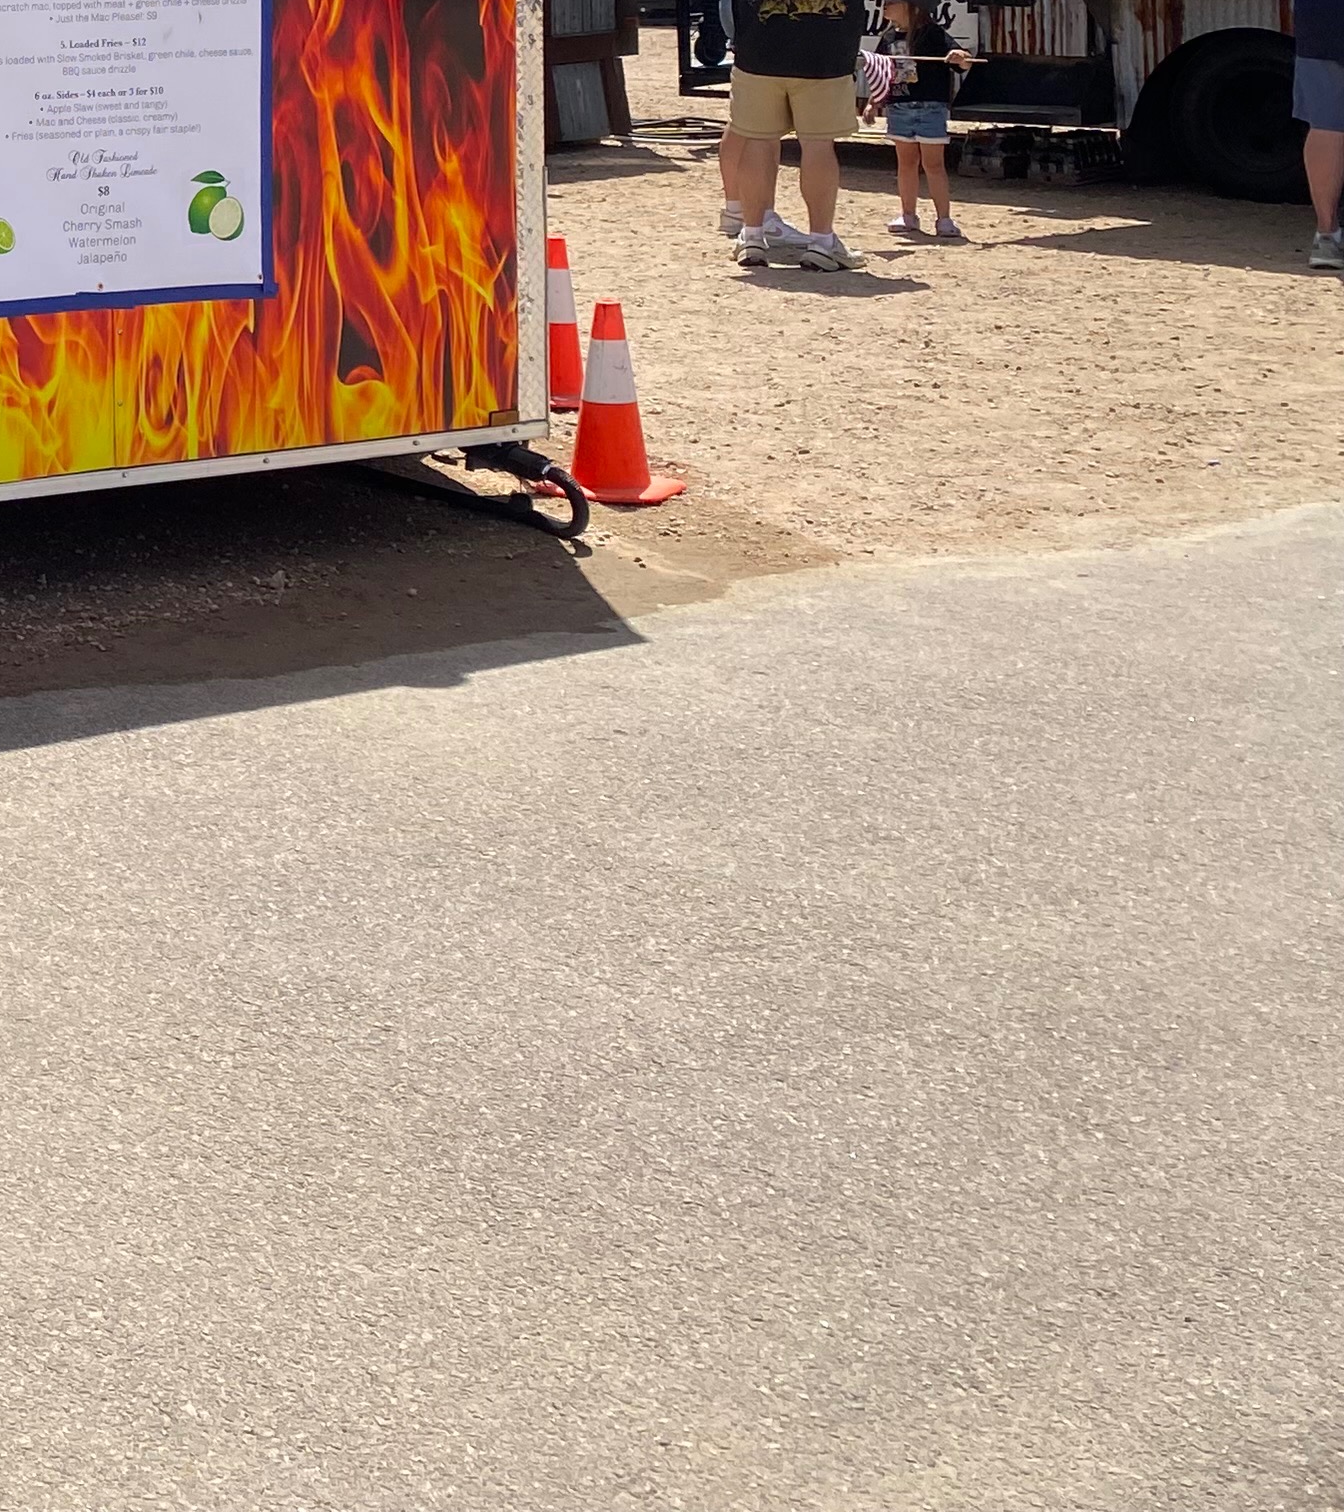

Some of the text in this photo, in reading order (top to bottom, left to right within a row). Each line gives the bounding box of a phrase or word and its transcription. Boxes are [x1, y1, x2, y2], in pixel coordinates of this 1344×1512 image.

[53, 1, 81, 11] topped
[83, 0, 102, 9] with
[104, 0, 125, 8] meat
[136, 0, 160, 9] green
[56, 14, 73, 23] Just
[76, 14, 89, 22] the
[91, 13, 109, 21] Mac
[147, 11, 157, 20] $9
[70, 39, 99, 48] Loaded
[102, 39, 123, 47] Fries
[133, 38, 146, 46] $12
[6, 56, 35, 65] loaded
[57, 54, 77, 63] Slow
[79, 53, 111, 62] Smoked
[148, 52, 173, 61] green
[63, 65, 136, 76] BBQ sauce drizzle
[57, 91, 79, 99] Sides
[98, 89, 116, 97] each
[136, 87, 148, 95] for
[150, 87, 164, 95] $10
[47, 100, 168, 114] Apple Slaw (sweet and tangy)
[36, 118, 55, 126] Mac
[58, 117, 74, 126] and
[76, 116, 106, 125] Cheese
[143, 112, 178, 121] creamy)
[12, 131, 34, 140] Fries
[36, 130, 81, 140] (seasoned
[125, 128, 151, 136] crispy
[153, 125, 168, 134] fair
[68, 150, 89, 165] Old
[46, 168, 77, 181] Hand
[98, 186, 109, 197] $8
[81, 202, 125, 216] Original
[63, 218, 142, 232] Cherry Smash
[69, 236, 136, 248] Watermelon
[77, 251, 127, 265] Jalapeño
